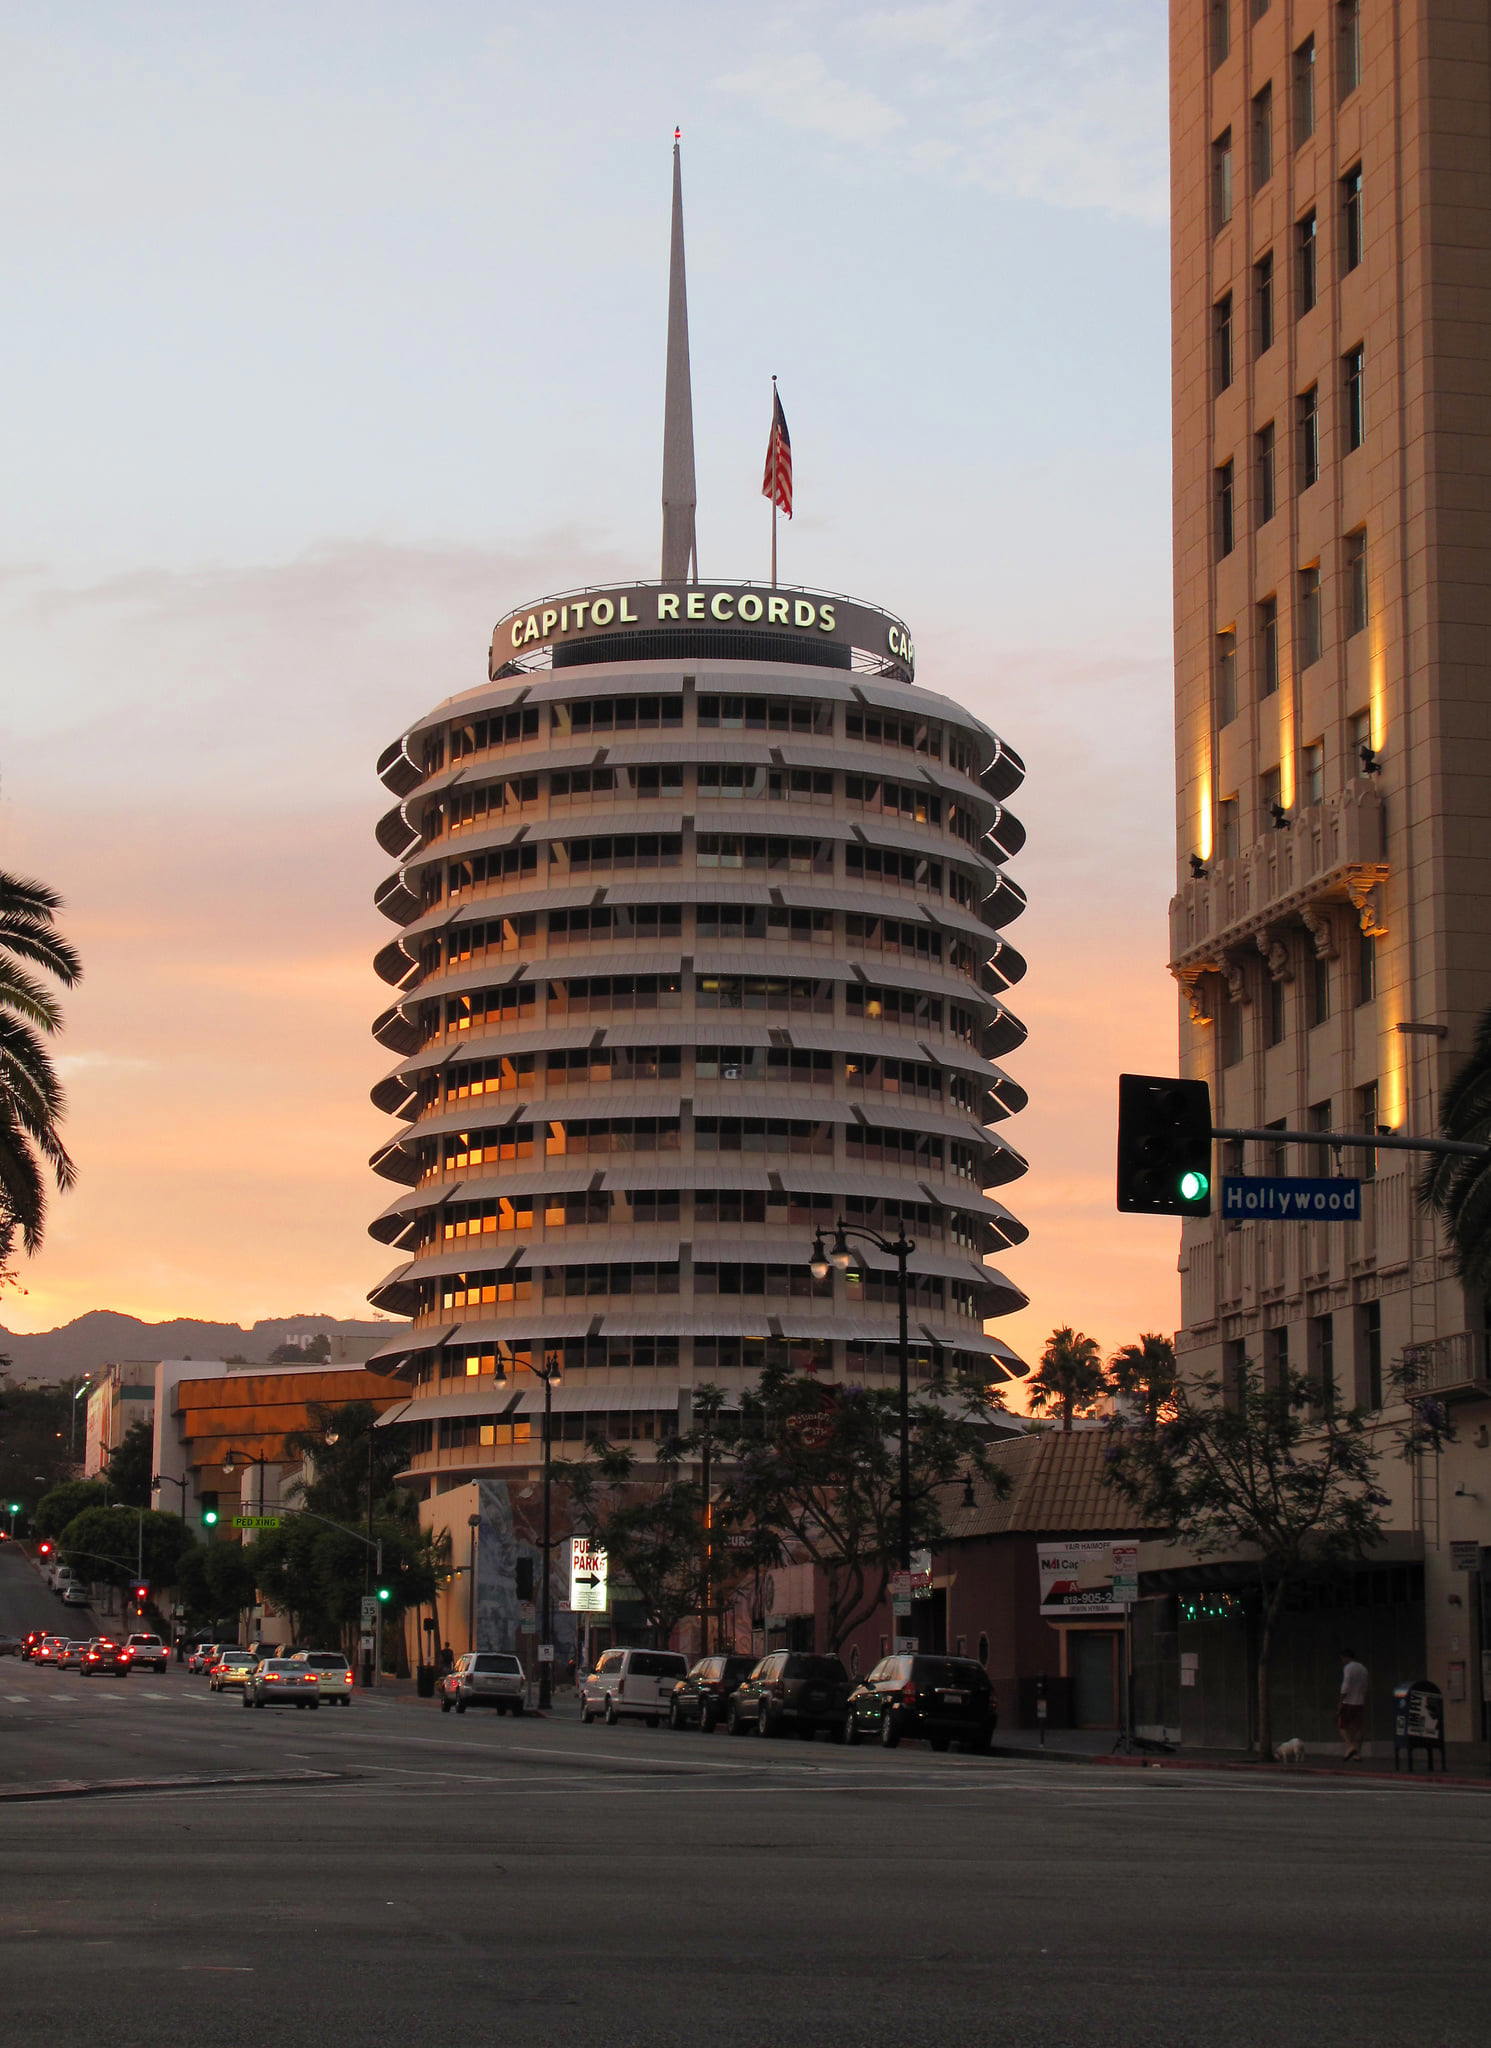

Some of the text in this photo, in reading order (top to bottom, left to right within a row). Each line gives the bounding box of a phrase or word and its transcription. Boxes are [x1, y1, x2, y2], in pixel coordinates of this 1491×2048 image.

[511, 592, 836, 648] CAPITOL RECORDS
[1227, 1187, 1355, 1214] Hollywood
[236, 1518, 276, 1527] PED XING
[574, 1556, 603, 1571] PARK
[1061, 1559, 1079, 1570] Cap
[1063, 1592, 1113, 1604] 818-905-2
[363, 1607, 376, 1615] 35
